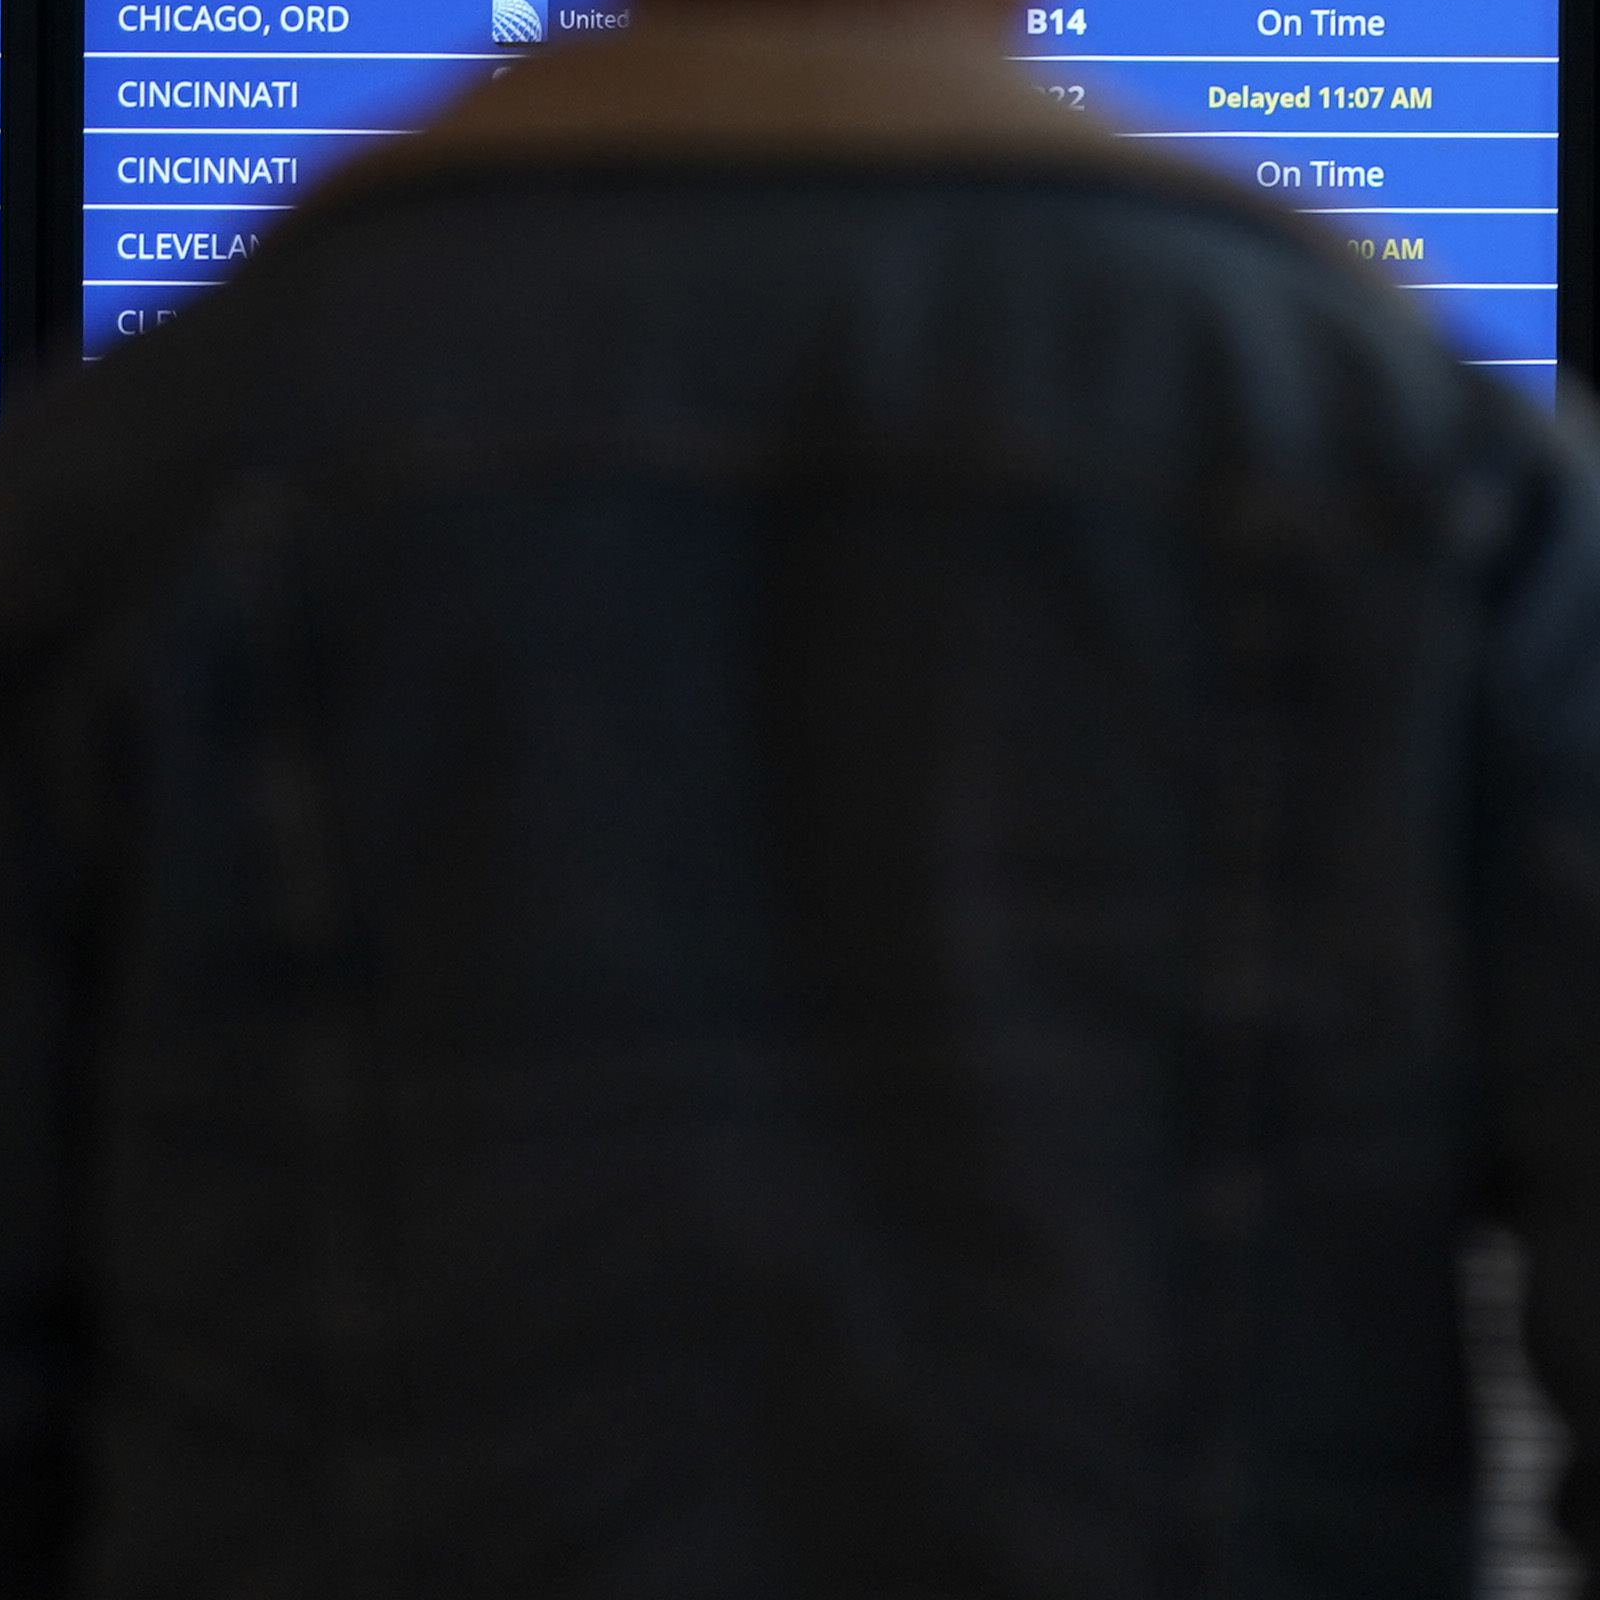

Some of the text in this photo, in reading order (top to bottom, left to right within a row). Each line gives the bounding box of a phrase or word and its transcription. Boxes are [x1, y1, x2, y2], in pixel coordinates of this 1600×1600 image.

[118, 4, 270, 36] CHICAGO,
[279, 5, 350, 33] ORD
[1027, 8, 1088, 36] B14
[1257, 9, 1302, 36] On
[1310, 8, 1385, 37] Time
[117, 80, 1432, 116] CINCINNATI Delayed 11:07 AM
[116, 232, 261, 262] CLEVELA
